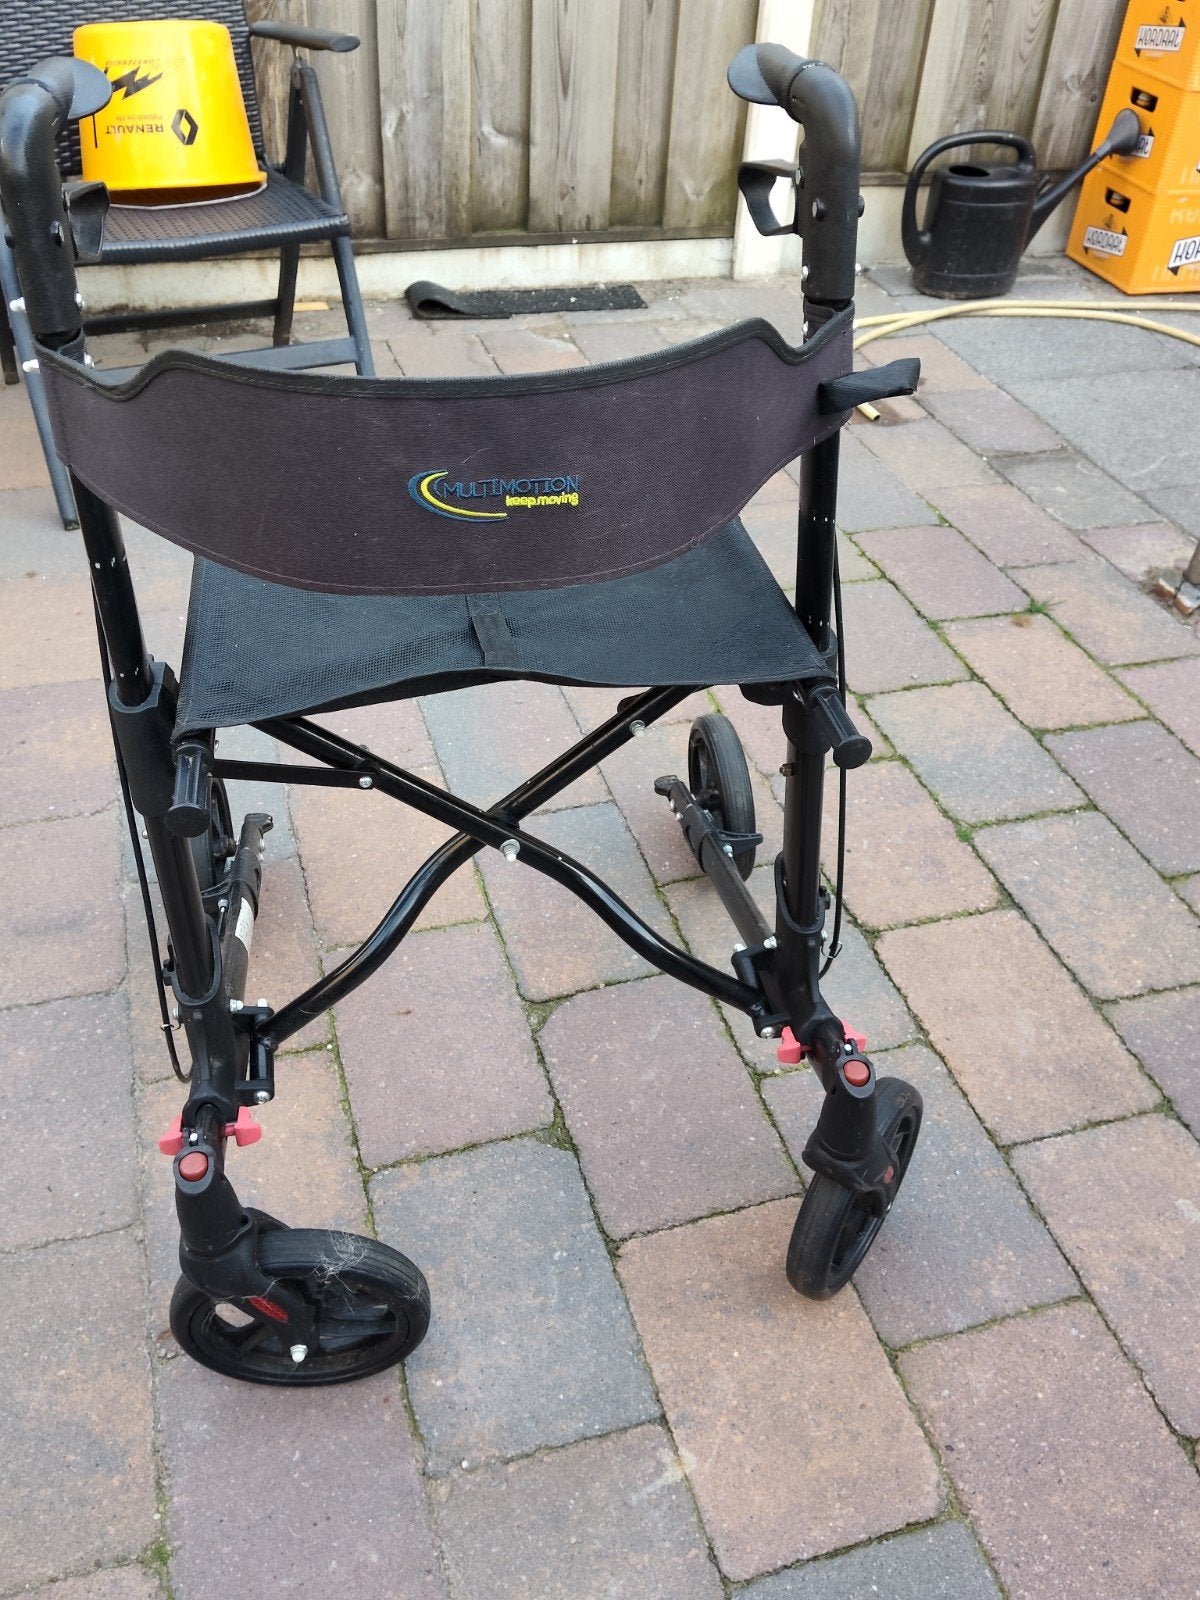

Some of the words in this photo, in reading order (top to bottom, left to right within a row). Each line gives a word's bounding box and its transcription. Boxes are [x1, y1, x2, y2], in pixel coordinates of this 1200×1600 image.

[105, 124, 164, 135] RENAULT
[443, 475, 579, 499] MULTIMOTION
[505, 495, 535, 508] keep
[537, 492, 579, 506] moving
